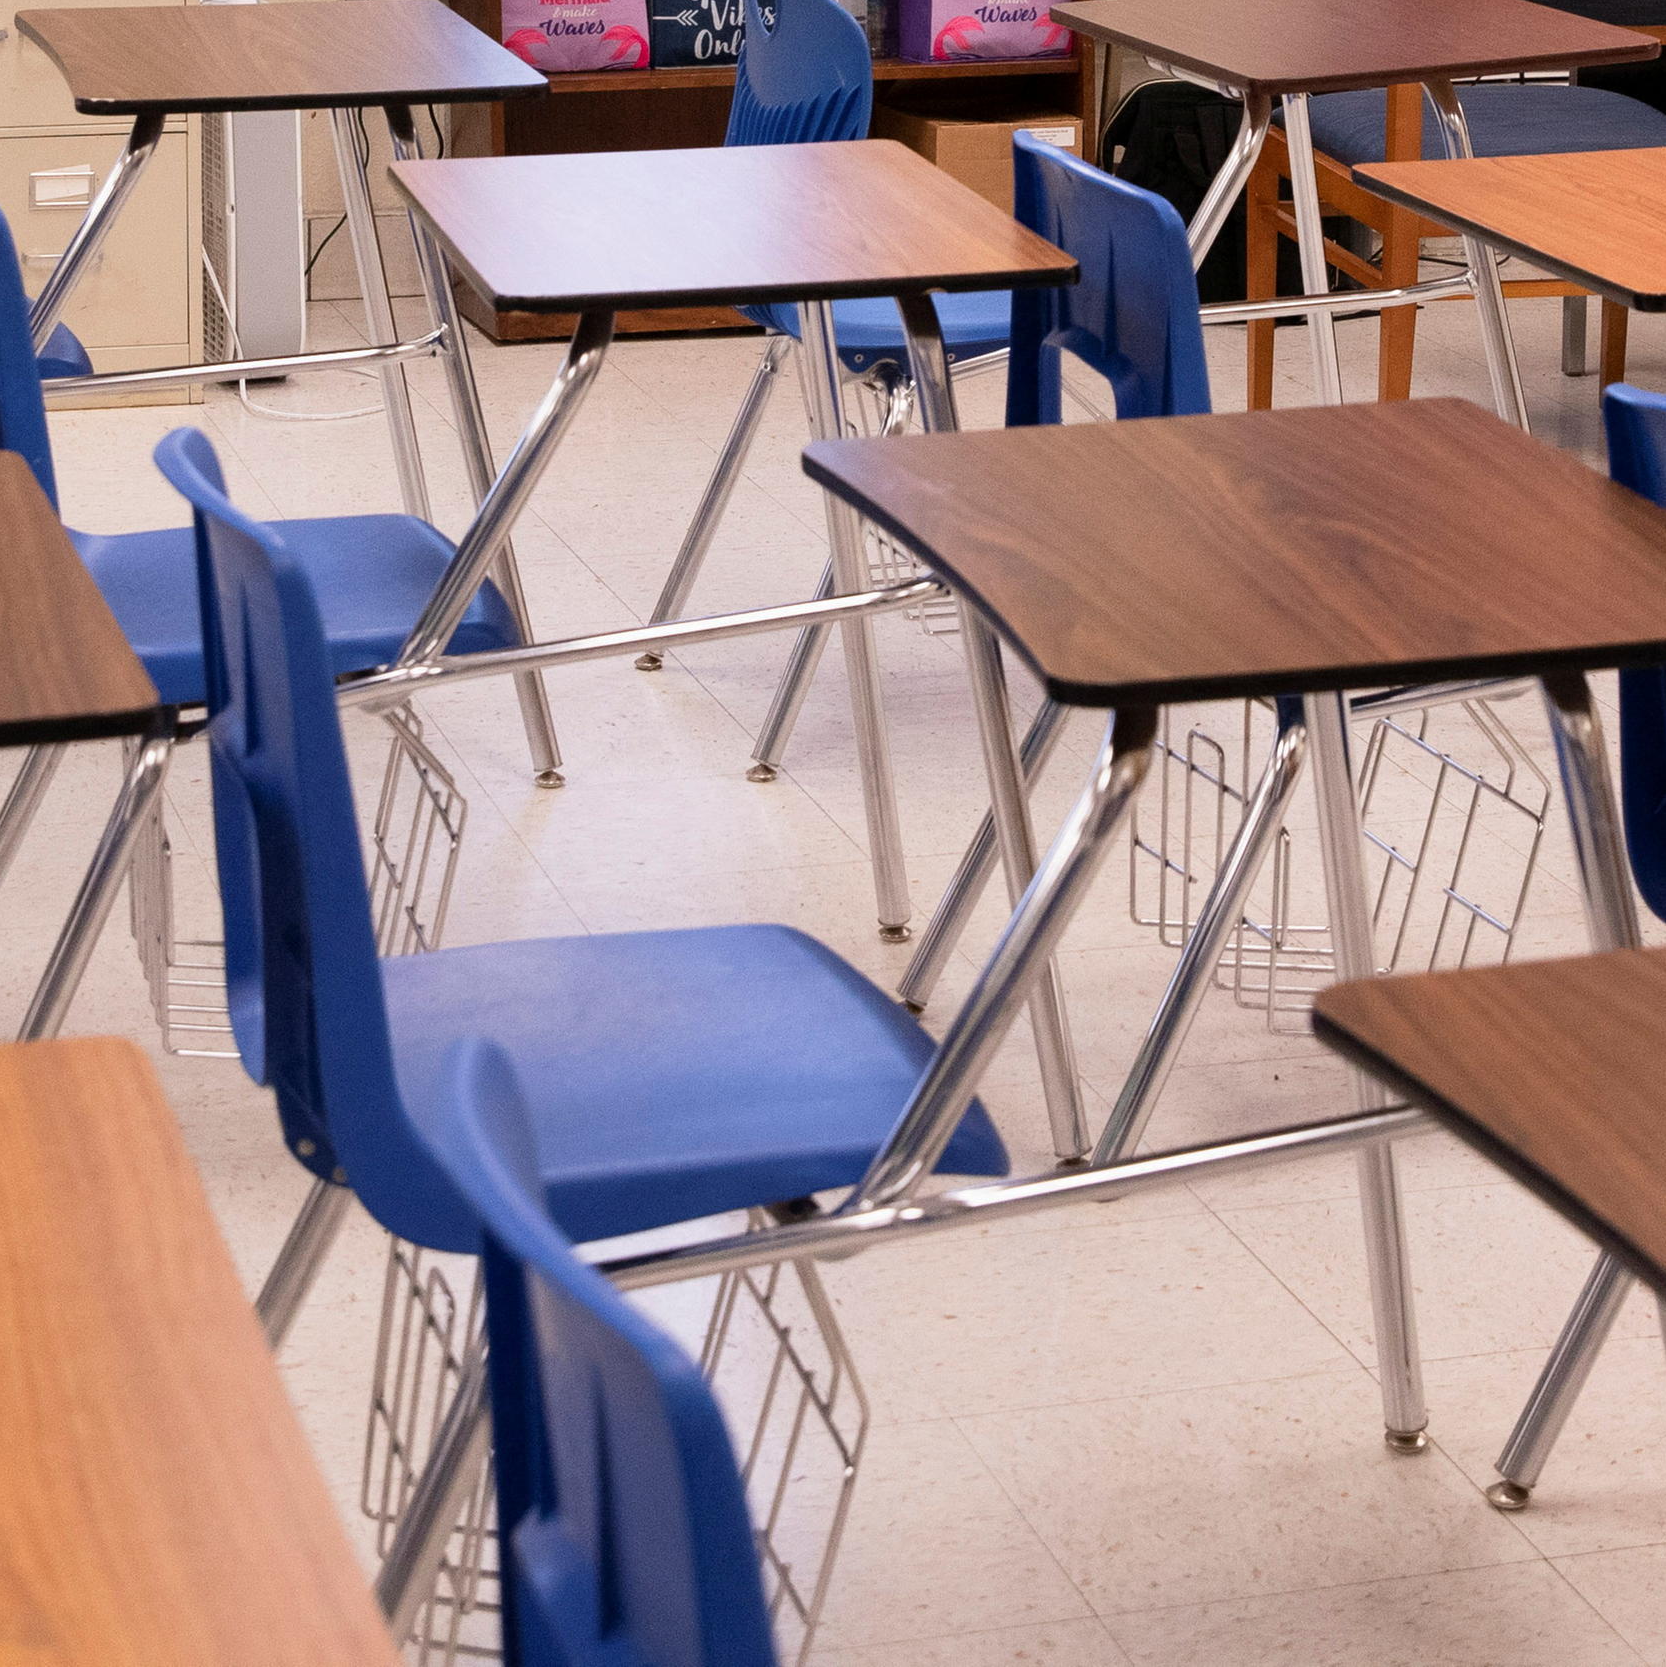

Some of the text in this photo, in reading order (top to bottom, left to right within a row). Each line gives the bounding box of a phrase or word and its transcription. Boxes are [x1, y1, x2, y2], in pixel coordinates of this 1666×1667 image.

[975, 6, 1037, 23] Waves
[540, 19, 605, 37] Waves
[694, 29, 745, 60] Onl
